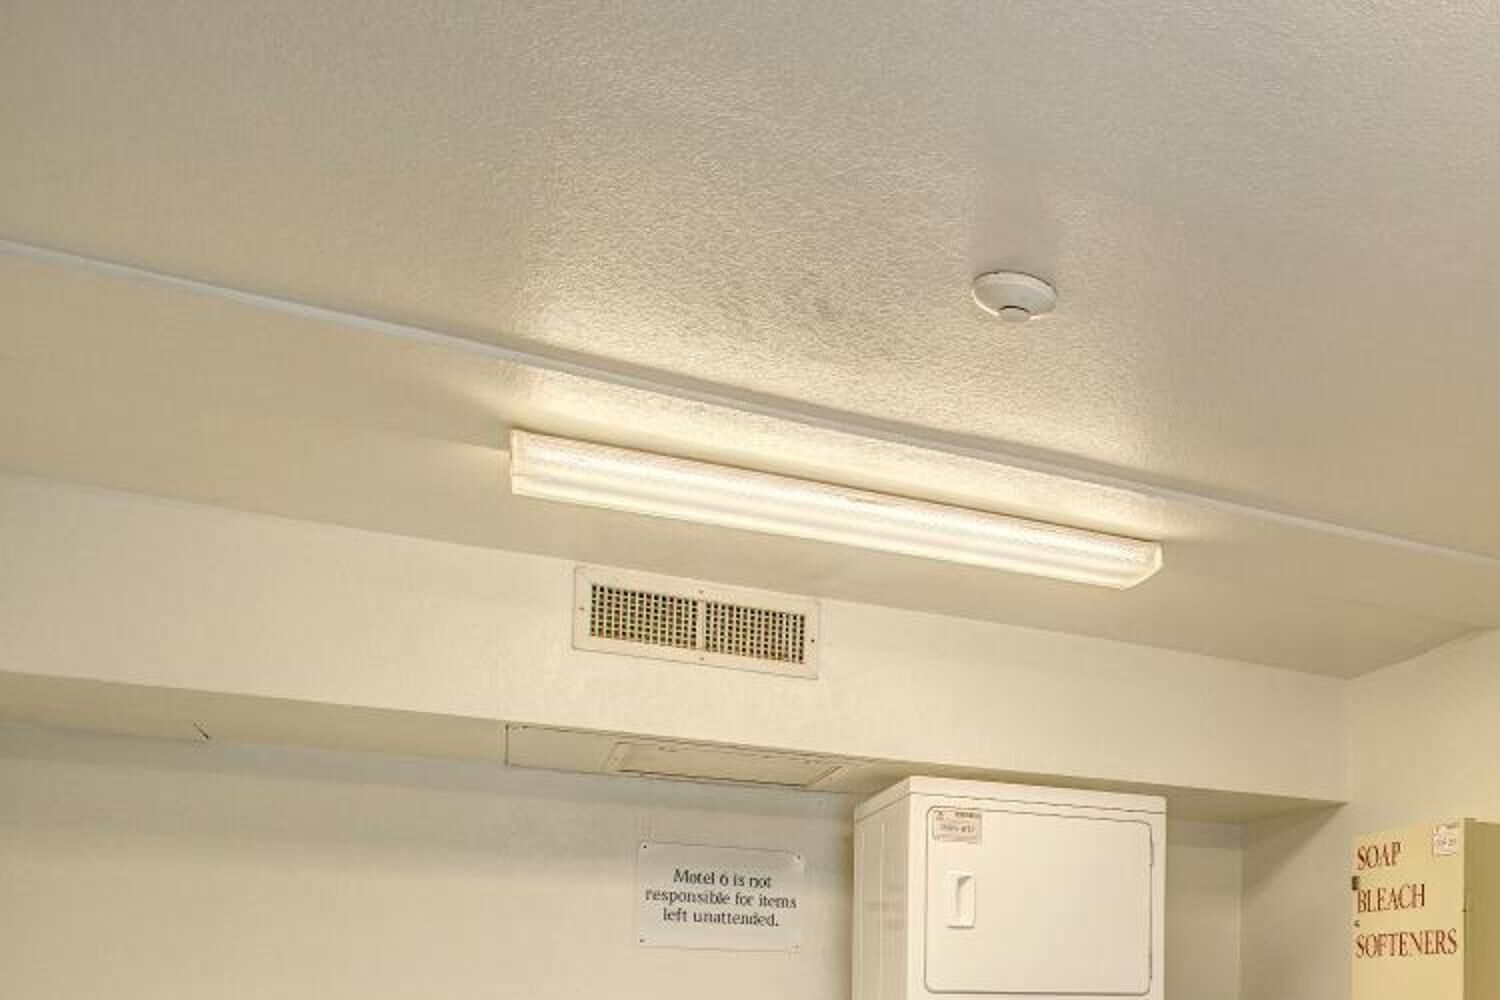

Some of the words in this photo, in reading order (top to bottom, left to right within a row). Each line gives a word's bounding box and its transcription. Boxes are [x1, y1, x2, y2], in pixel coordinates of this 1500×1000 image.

[1357, 841, 1401, 871] SOAP
[673, 868, 715, 885] Motel
[719, 872, 729, 887] 6
[733, 874, 745, 887] is
[749, 876, 773, 889] not
[645, 887, 731, 906] responsible
[735, 891, 753, 907] for
[758, 893, 797, 909] items
[1357, 883, 1425, 914] BLEACH
[663, 906, 688, 922] left
[693, 909, 779, 928] unattended.
[1356, 927, 1457, 959] SOFTENERS
